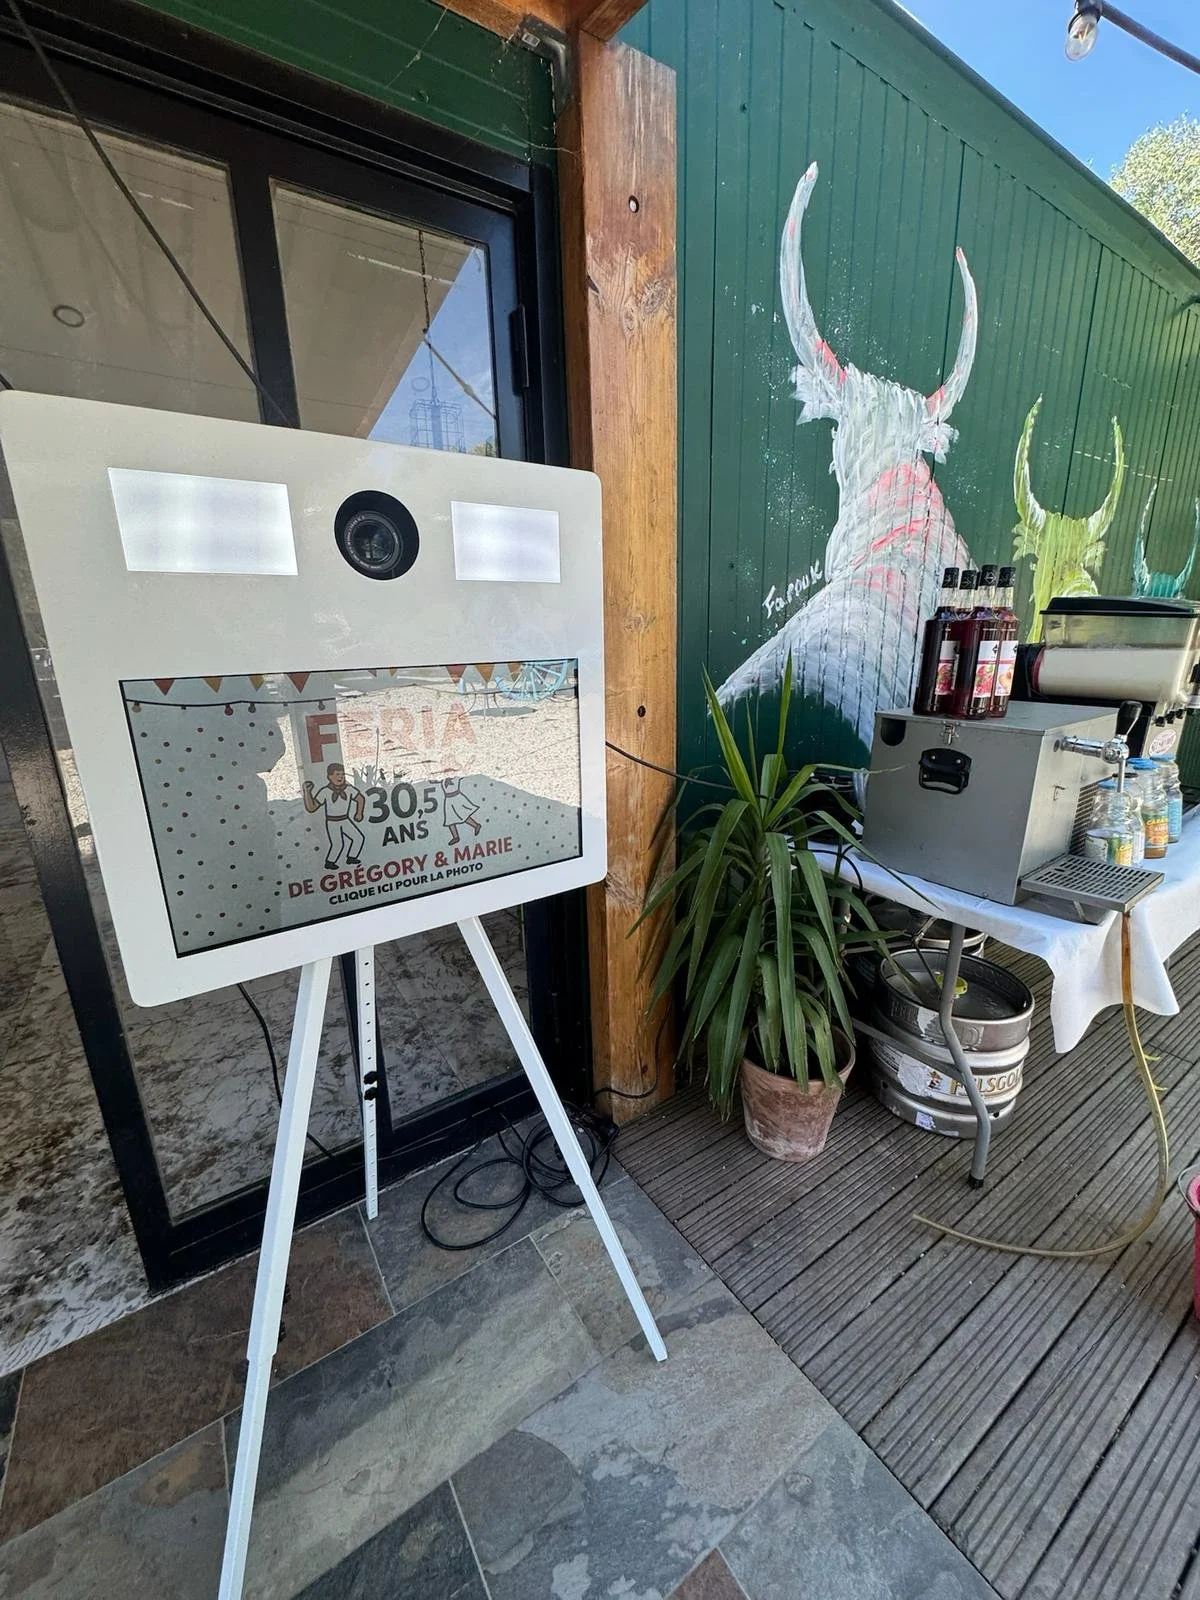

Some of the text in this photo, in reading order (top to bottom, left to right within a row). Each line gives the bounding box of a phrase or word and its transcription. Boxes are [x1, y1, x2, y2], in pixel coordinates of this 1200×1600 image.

[305, 703, 478, 764] FERIA
[365, 782, 438, 824] 30,5
[382, 820, 429, 847] ANS
[288, 836, 513, 898] DE GRÉGORY & MARIE
[329, 862, 483, 905] CLIQUE ICI POUR LA PHOTO
